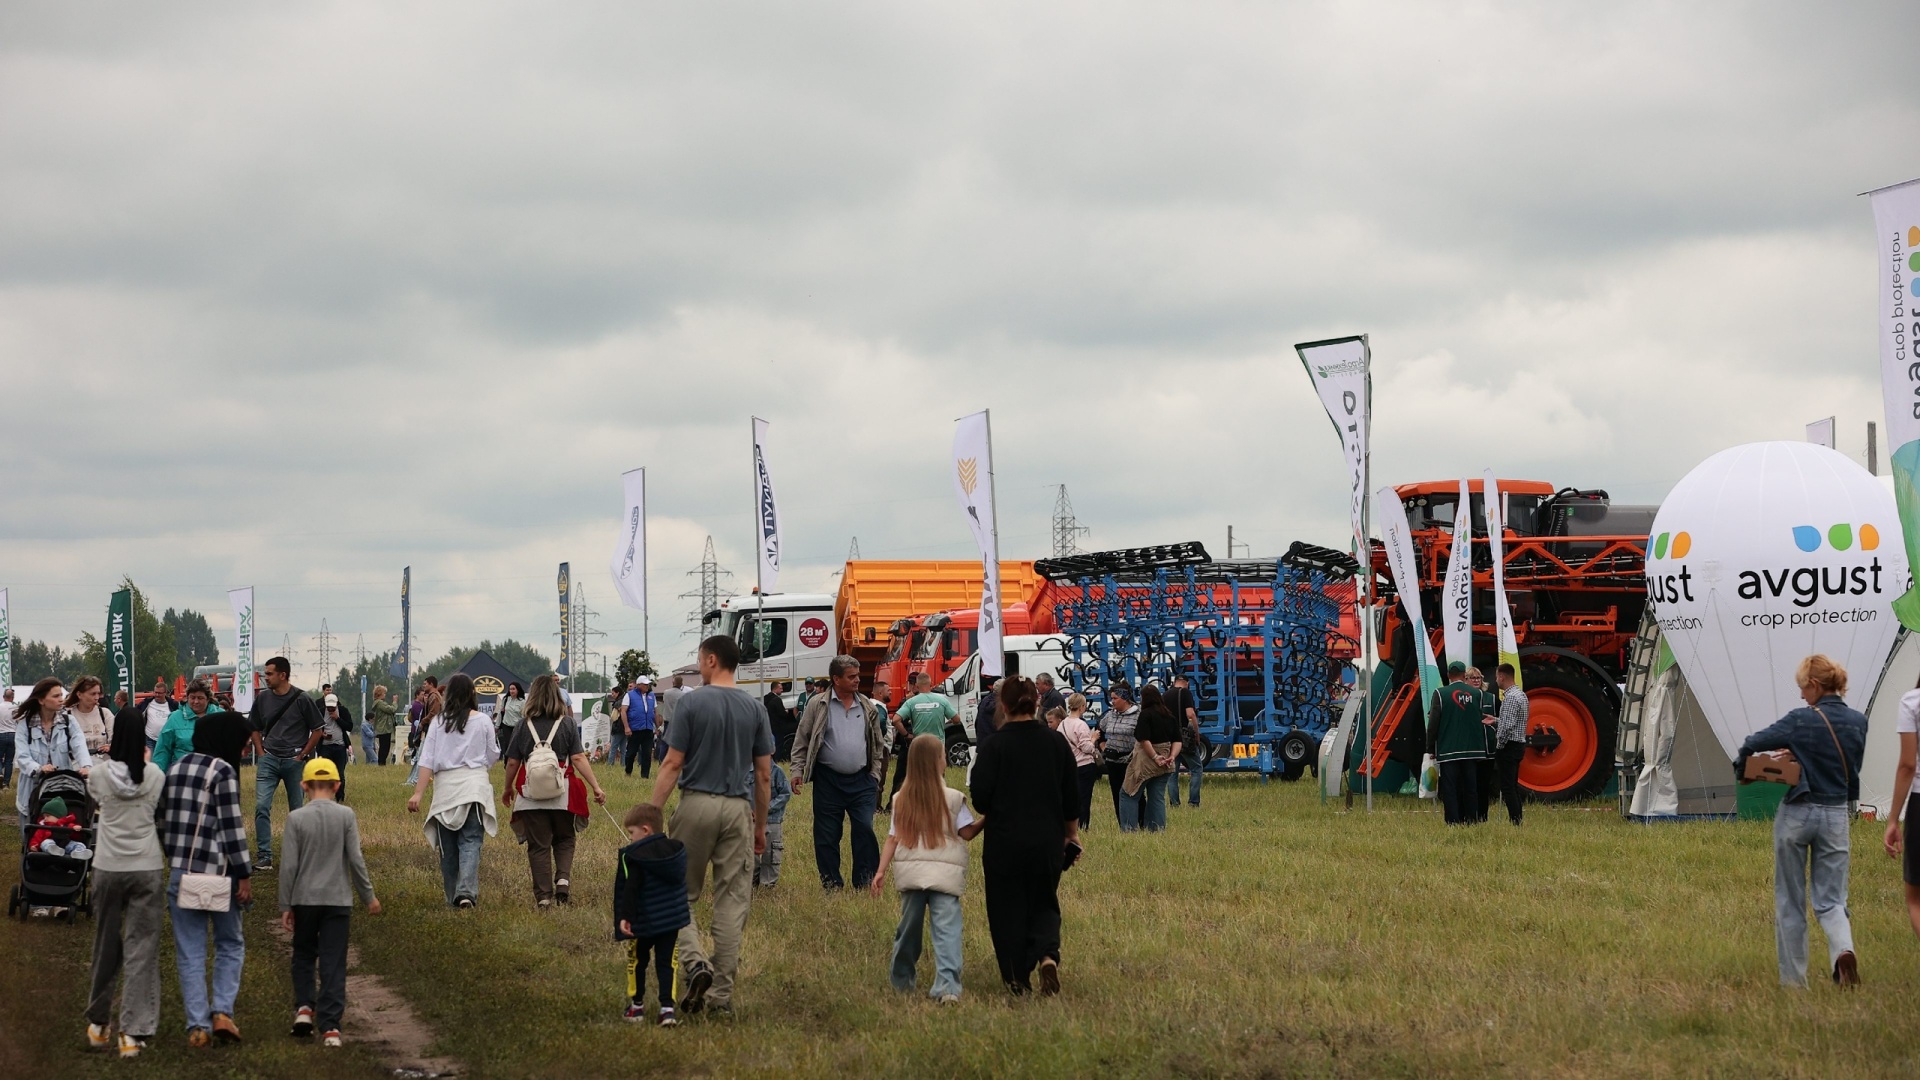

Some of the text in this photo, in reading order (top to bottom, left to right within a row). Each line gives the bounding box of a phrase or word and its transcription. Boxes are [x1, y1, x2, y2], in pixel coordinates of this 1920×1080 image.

[1737, 556, 1882, 608] avgust
[1740, 607, 1877, 629] crop protection
[800, 627, 814, 637] 28
